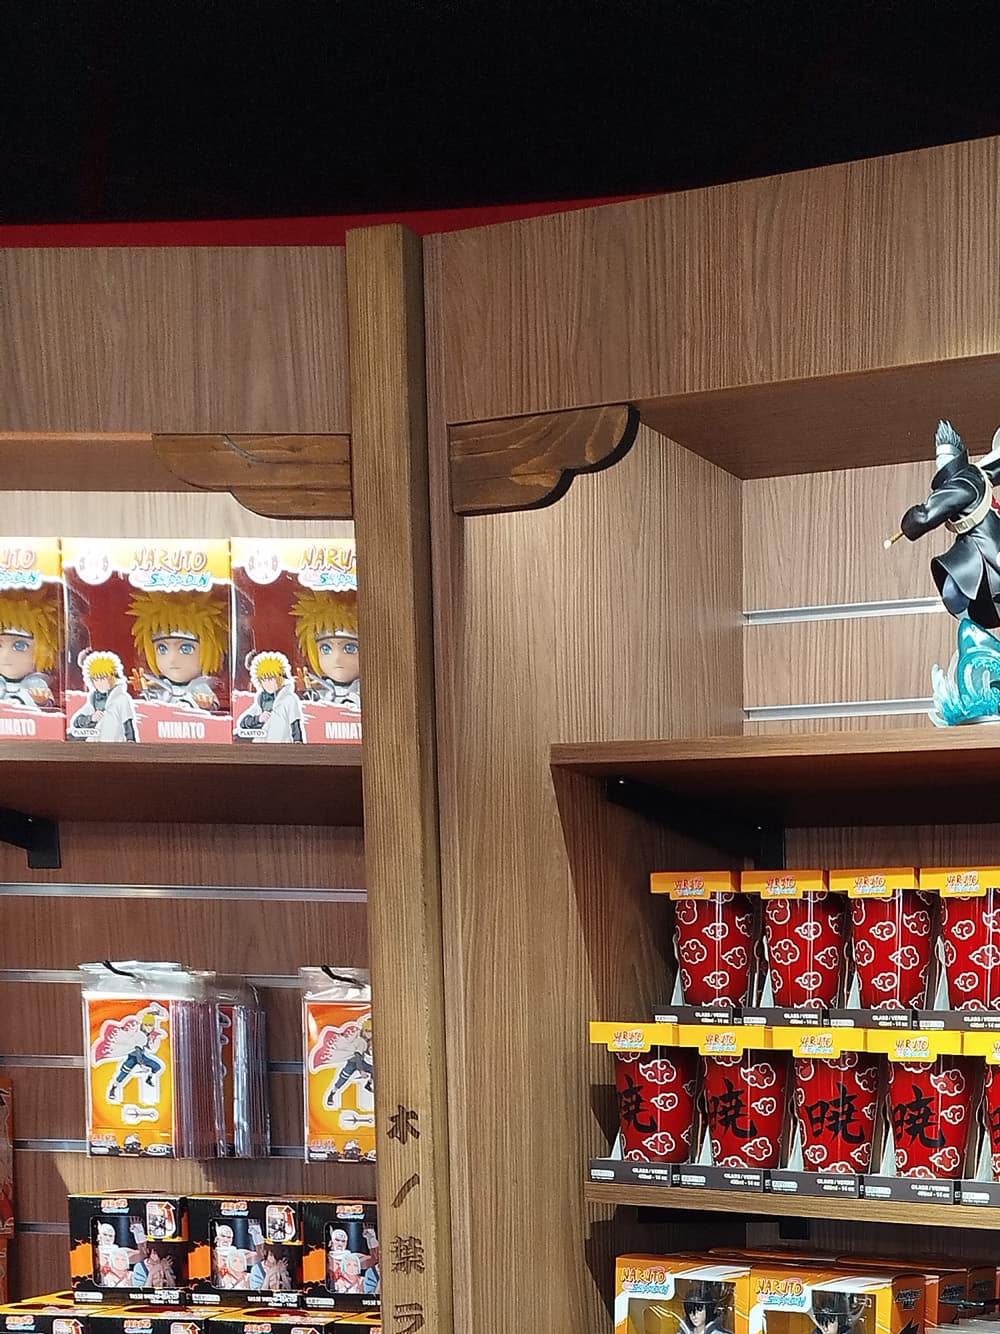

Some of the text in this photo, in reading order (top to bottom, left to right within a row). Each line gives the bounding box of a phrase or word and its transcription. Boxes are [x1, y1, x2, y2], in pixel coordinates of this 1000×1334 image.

[300, 544, 357, 573] NARU
[0, 718, 36, 736] INATO
[157, 721, 205, 739] MINATO
[325, 722, 362, 739] MINA
[621, 1266, 666, 1284] NARUTO
[756, 1279, 803, 1296] NARUTO
